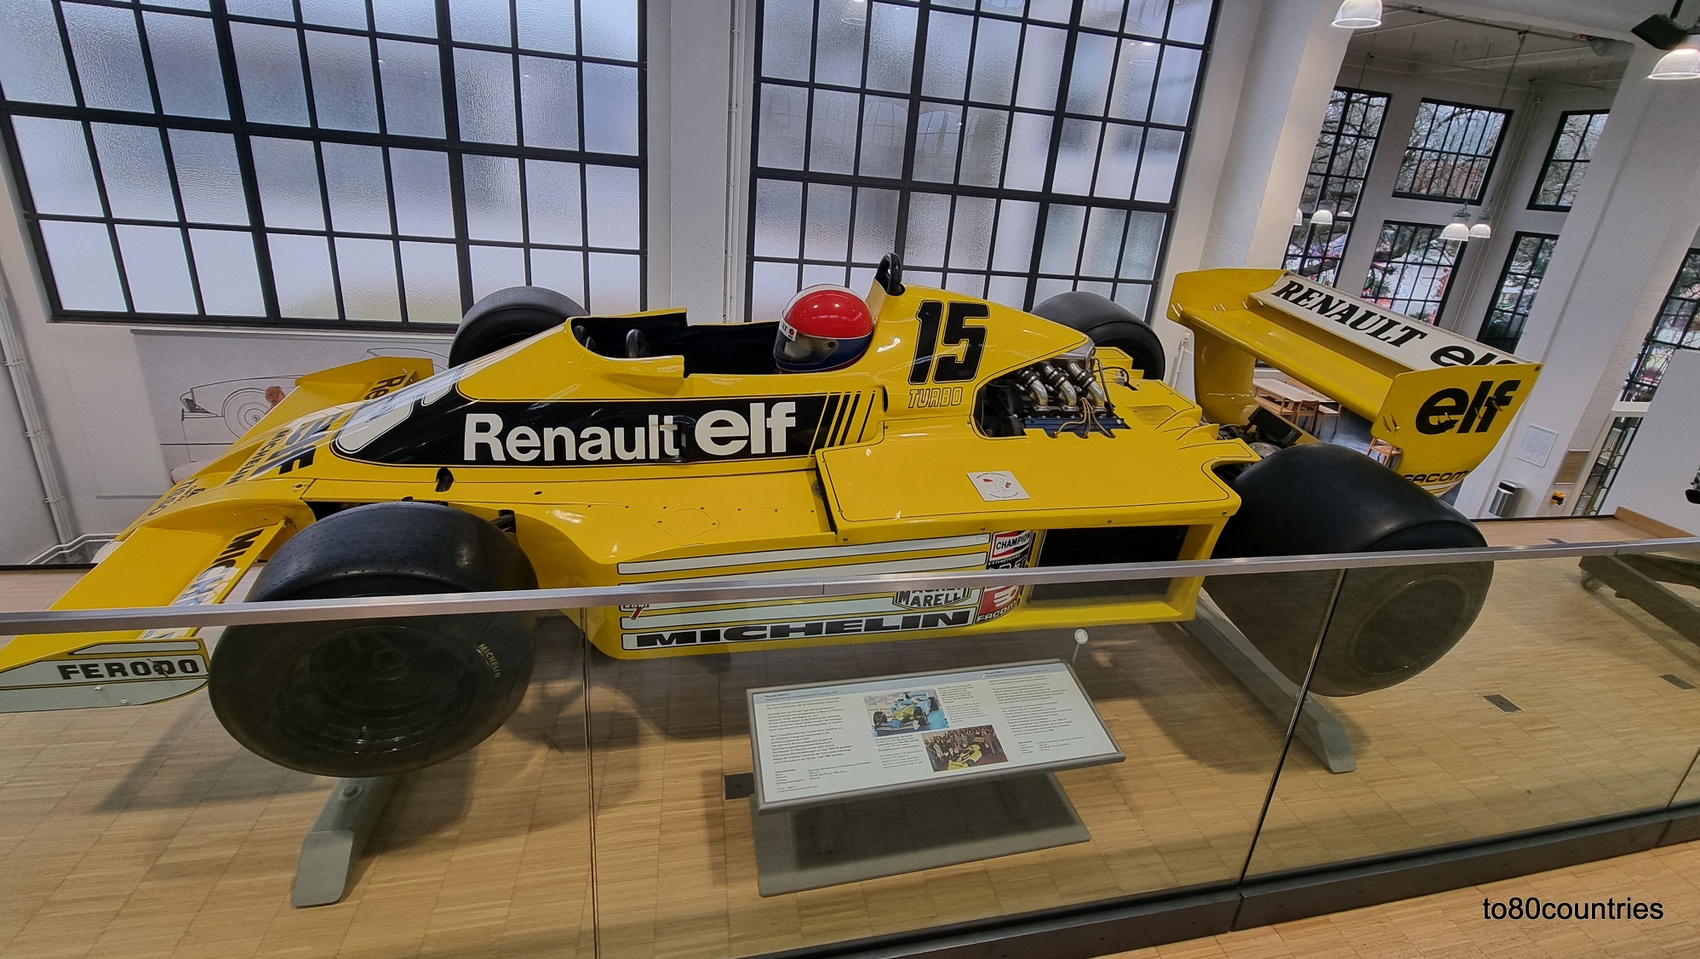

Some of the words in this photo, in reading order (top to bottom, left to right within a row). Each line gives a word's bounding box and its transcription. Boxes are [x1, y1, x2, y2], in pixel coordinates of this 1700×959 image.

[1271, 279, 1428, 348] RENAULT
[1430, 345, 1519, 366] el
[908, 300, 990, 385] 15
[907, 387, 963, 408] TURBO
[1415, 379, 1522, 436] elf
[463, 413, 680, 461] Renault
[694, 401, 796, 456] elf
[898, 587, 967, 607] MARELLI
[636, 610, 972, 648] MICHELIN
[57, 659, 200, 680] FERODO
[477, 643, 502, 679] MICHELIN
